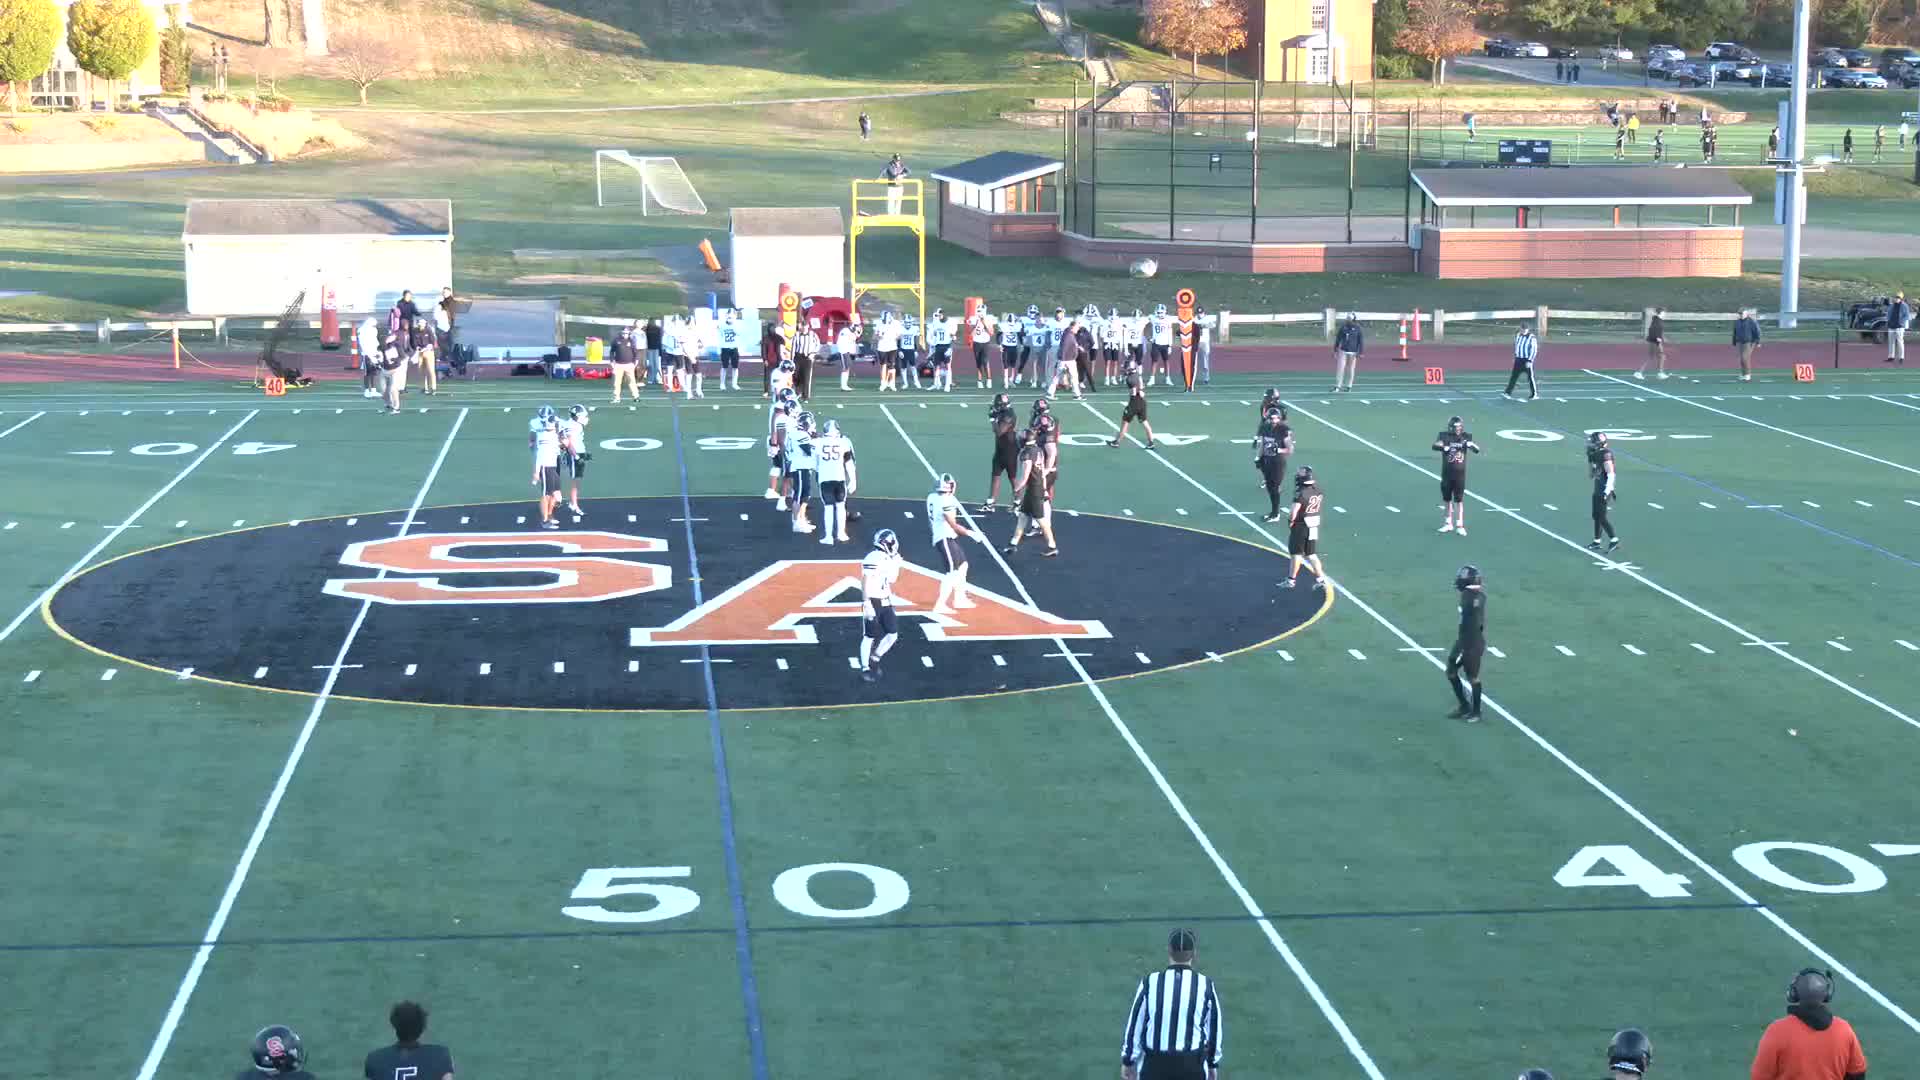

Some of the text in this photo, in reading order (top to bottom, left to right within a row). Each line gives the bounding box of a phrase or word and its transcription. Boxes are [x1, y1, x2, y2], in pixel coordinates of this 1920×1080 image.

[725, 331, 736, 342] 22
[1427, 368, 1441, 382] 30
[1799, 366, 1812, 380] 20
[267, 378, 283, 393] 40
[130, 442, 297, 456] 40
[600, 437, 757, 450] 50
[822, 445, 840, 461] 55
[1553, 841, 1888, 898] 40
[561, 862, 910, 922] 50
